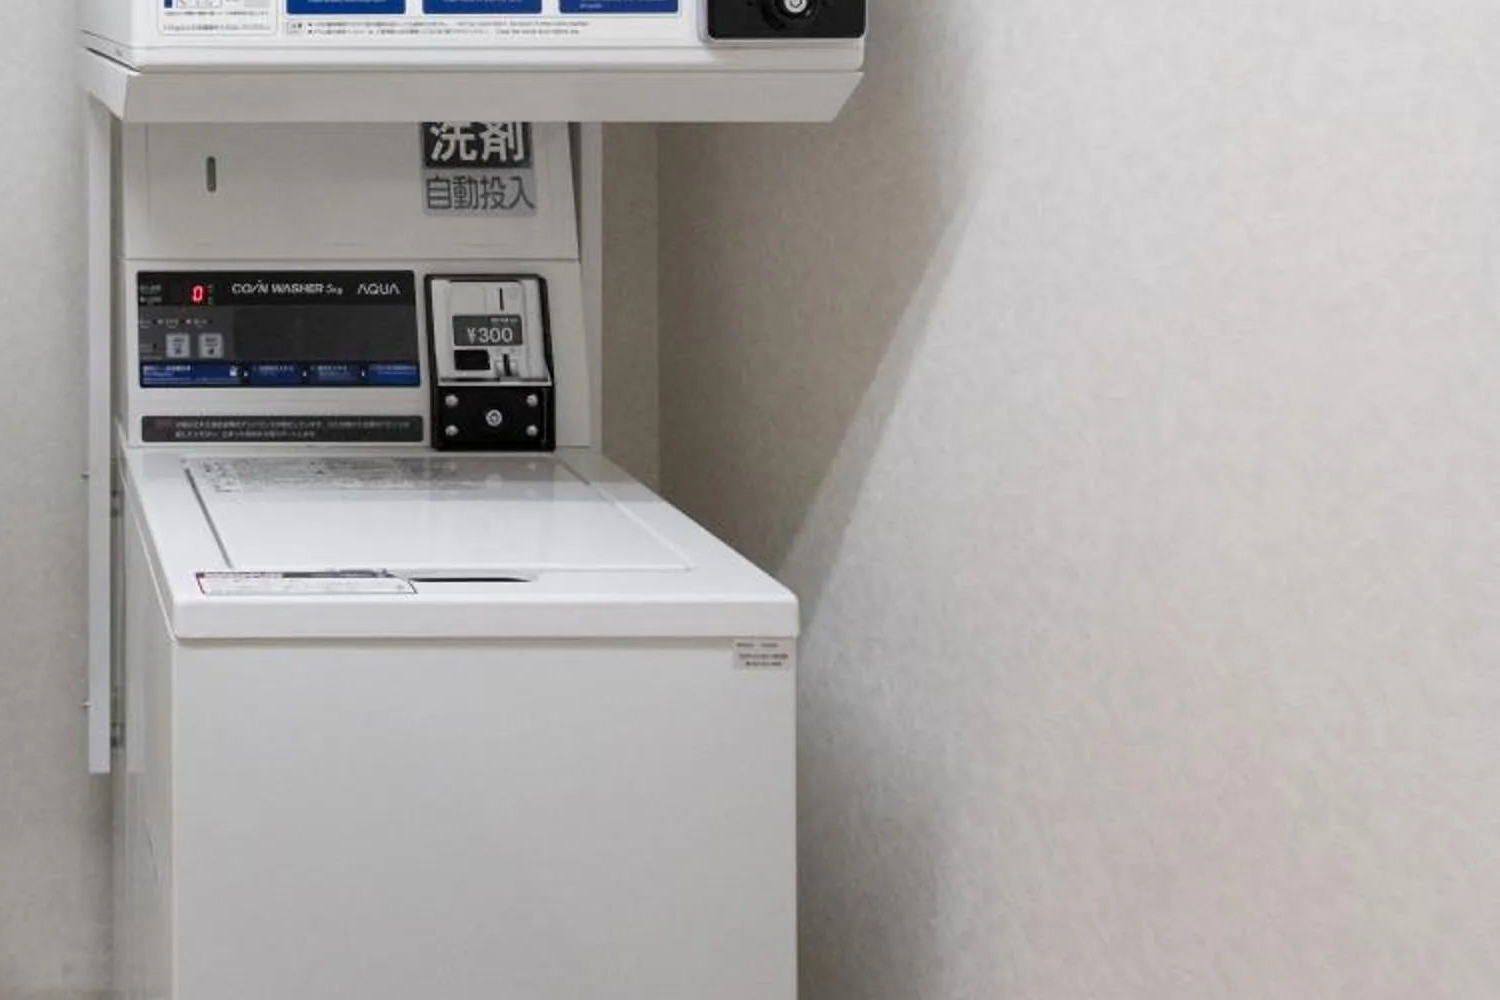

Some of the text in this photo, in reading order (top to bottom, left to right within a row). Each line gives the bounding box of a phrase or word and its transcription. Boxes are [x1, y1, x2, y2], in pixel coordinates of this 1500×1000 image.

[429, 122, 525, 163] 洗剤
[426, 175, 536, 211] 自動投入
[192, 284, 204, 302] 0
[271, 283, 325, 295] WASHER
[357, 282, 401, 295] AQUA
[466, 326, 514, 344] ¥300
